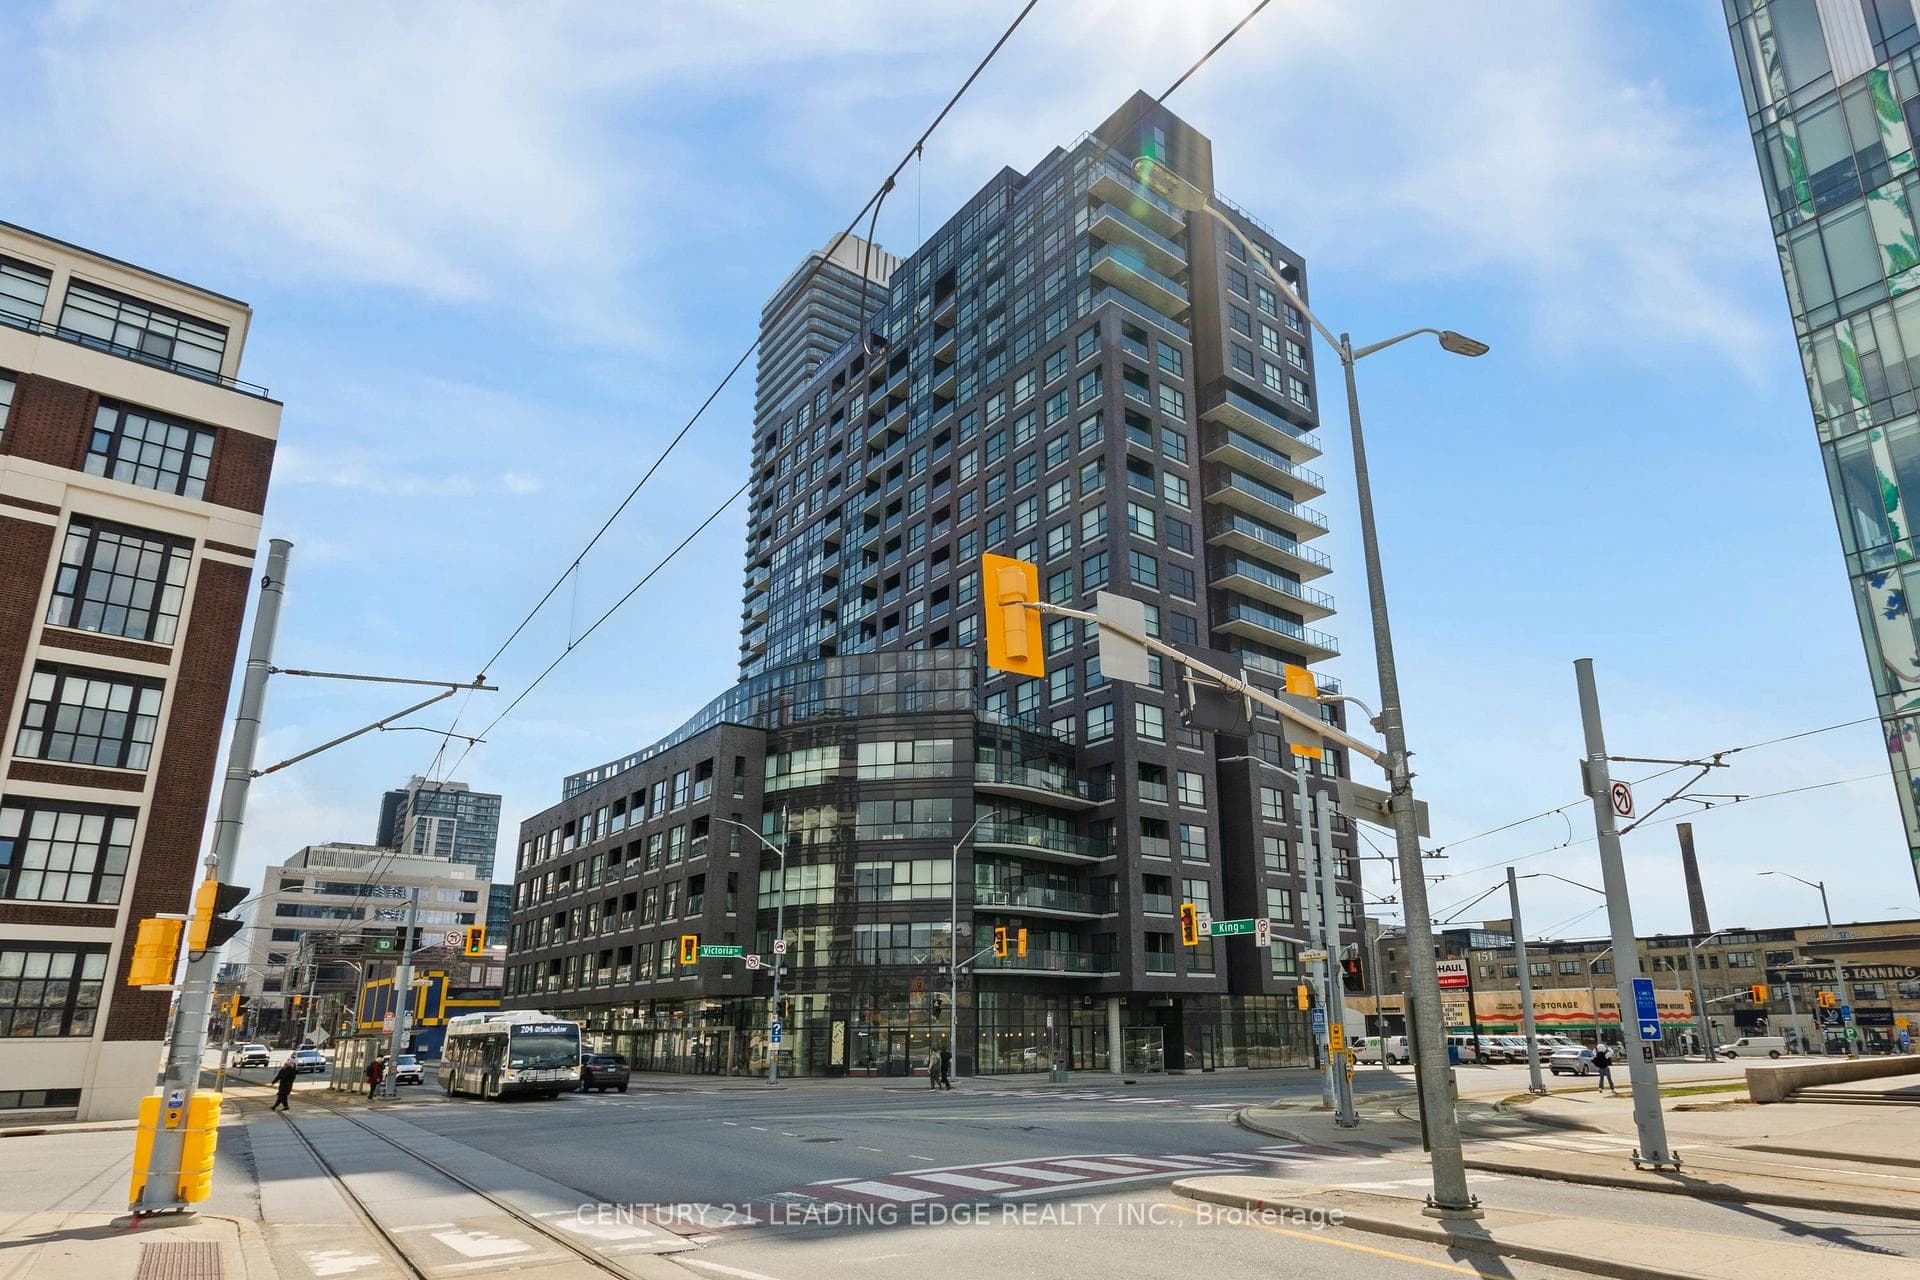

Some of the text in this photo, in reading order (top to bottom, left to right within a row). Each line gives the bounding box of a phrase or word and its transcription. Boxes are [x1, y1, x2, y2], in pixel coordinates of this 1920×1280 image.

[1219, 922, 1239, 933] King
[379, 941, 390, 949] TD
[703, 946, 734, 955] Victoria
[1476, 951, 1493, 962] 151
[1436, 964, 1465, 973] -HAUL
[1816, 968, 1850, 980] LANG
[1852, 966, 1916, 979] TANNING
[1518, 1001, 1579, 1009] SF-STORAGE
[521, 1026, 533, 1034] 204
